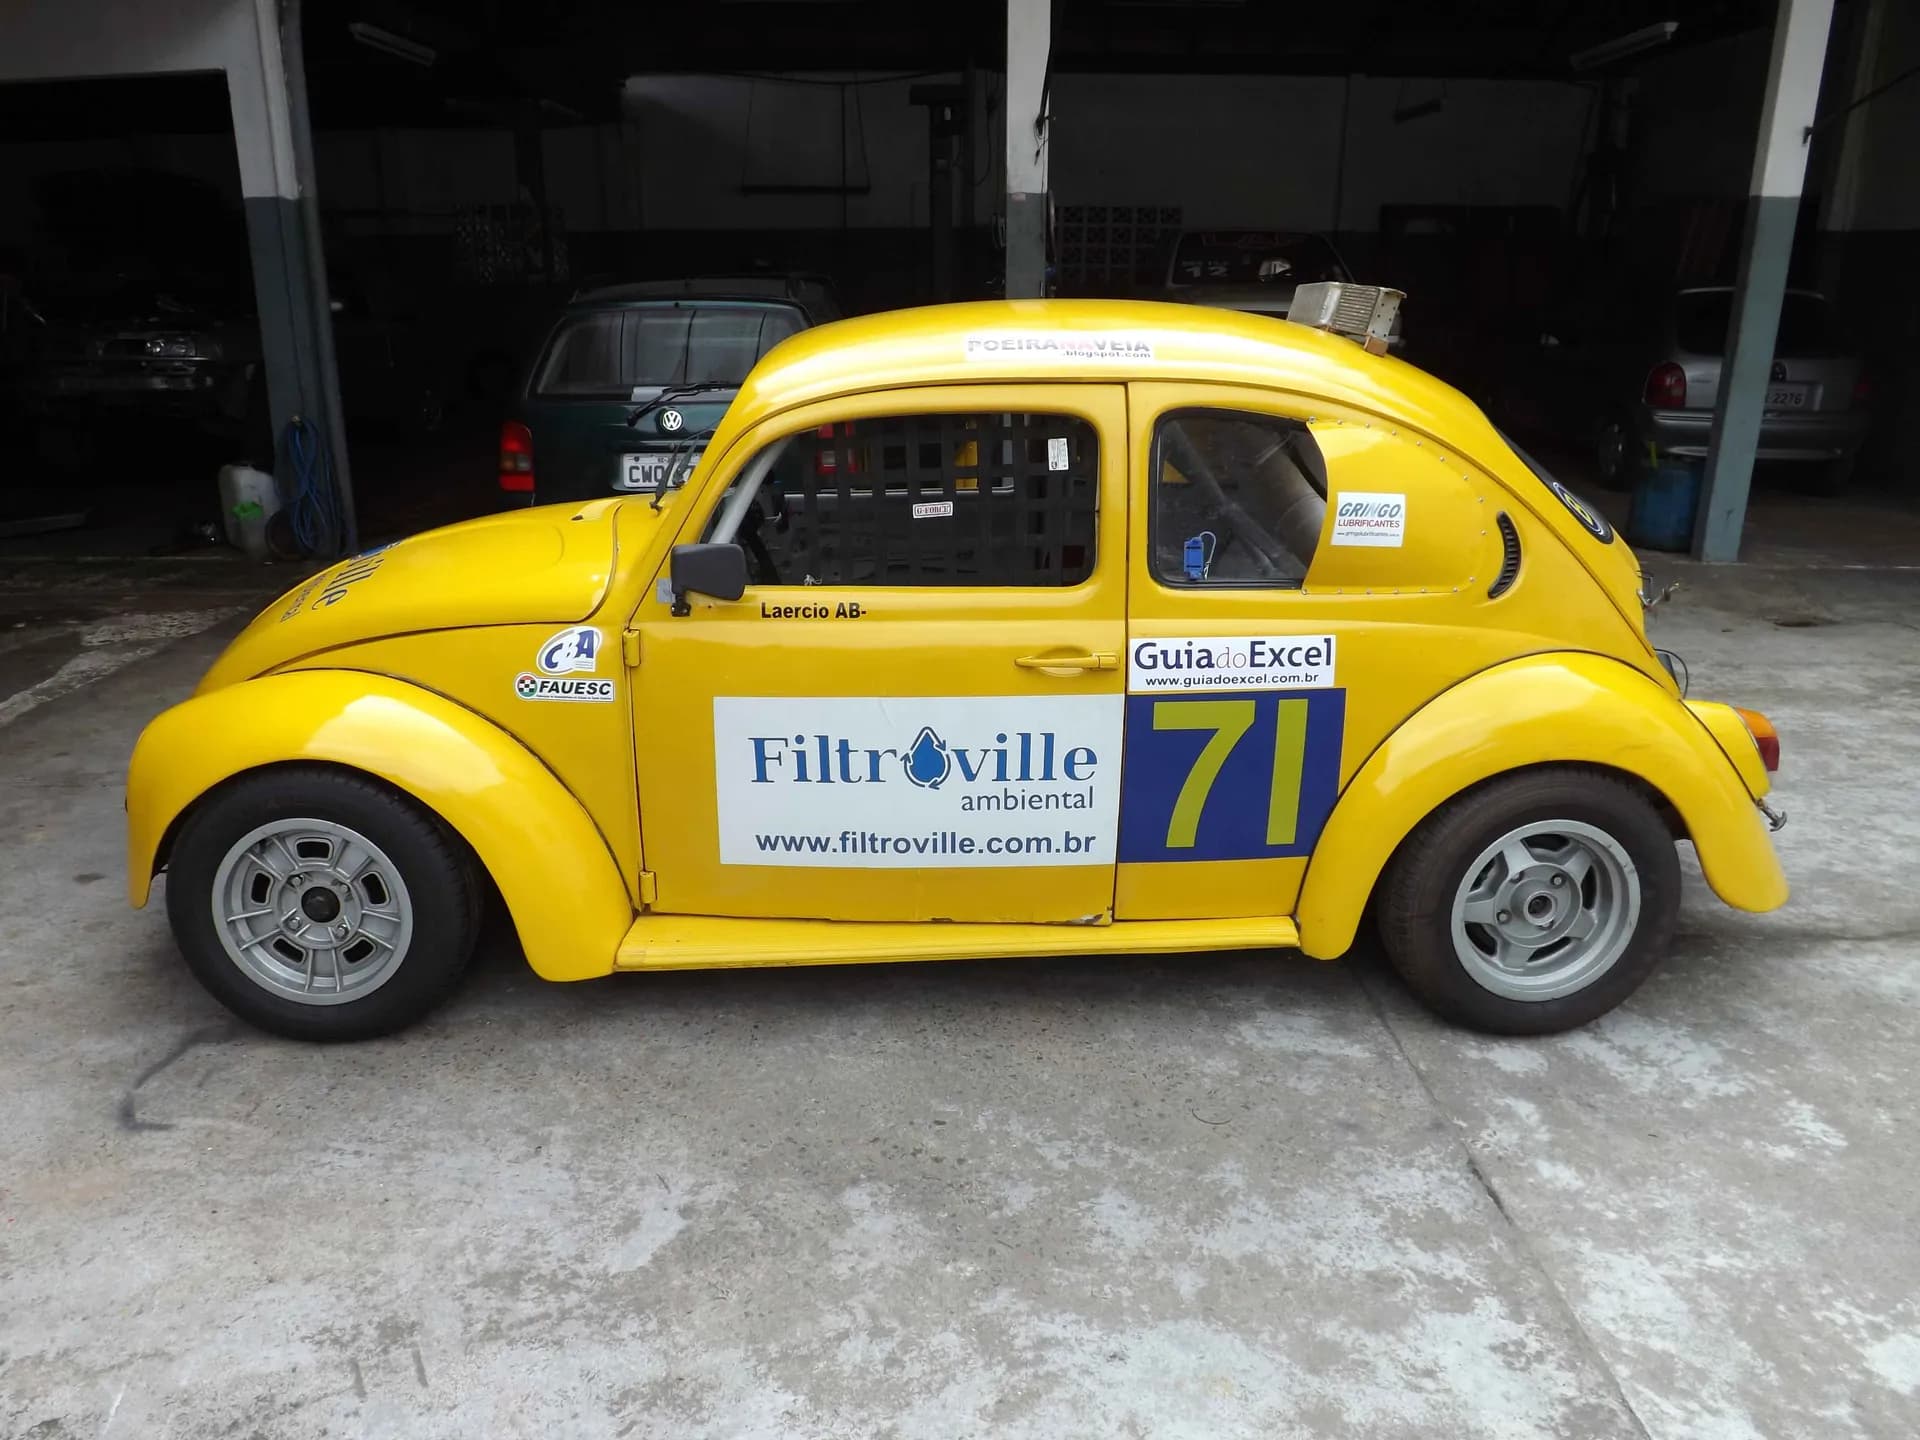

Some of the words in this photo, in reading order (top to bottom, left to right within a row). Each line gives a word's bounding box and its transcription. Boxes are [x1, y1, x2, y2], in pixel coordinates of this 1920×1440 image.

[1338, 502, 1402, 518] GRINGO
[1337, 519, 1400, 528] LUBRIFICANTES
[761, 602, 829, 619] Laercio
[835, 602, 867, 619] AB-
[538, 680, 612, 696] FAUESC
[1145, 673, 1319, 687] www.guiadoexcel.com.br
[1152, 698, 1309, 848] 71
[960, 786, 1094, 812] ambiental
[755, 831, 1097, 854] www.filtroville.com.br
